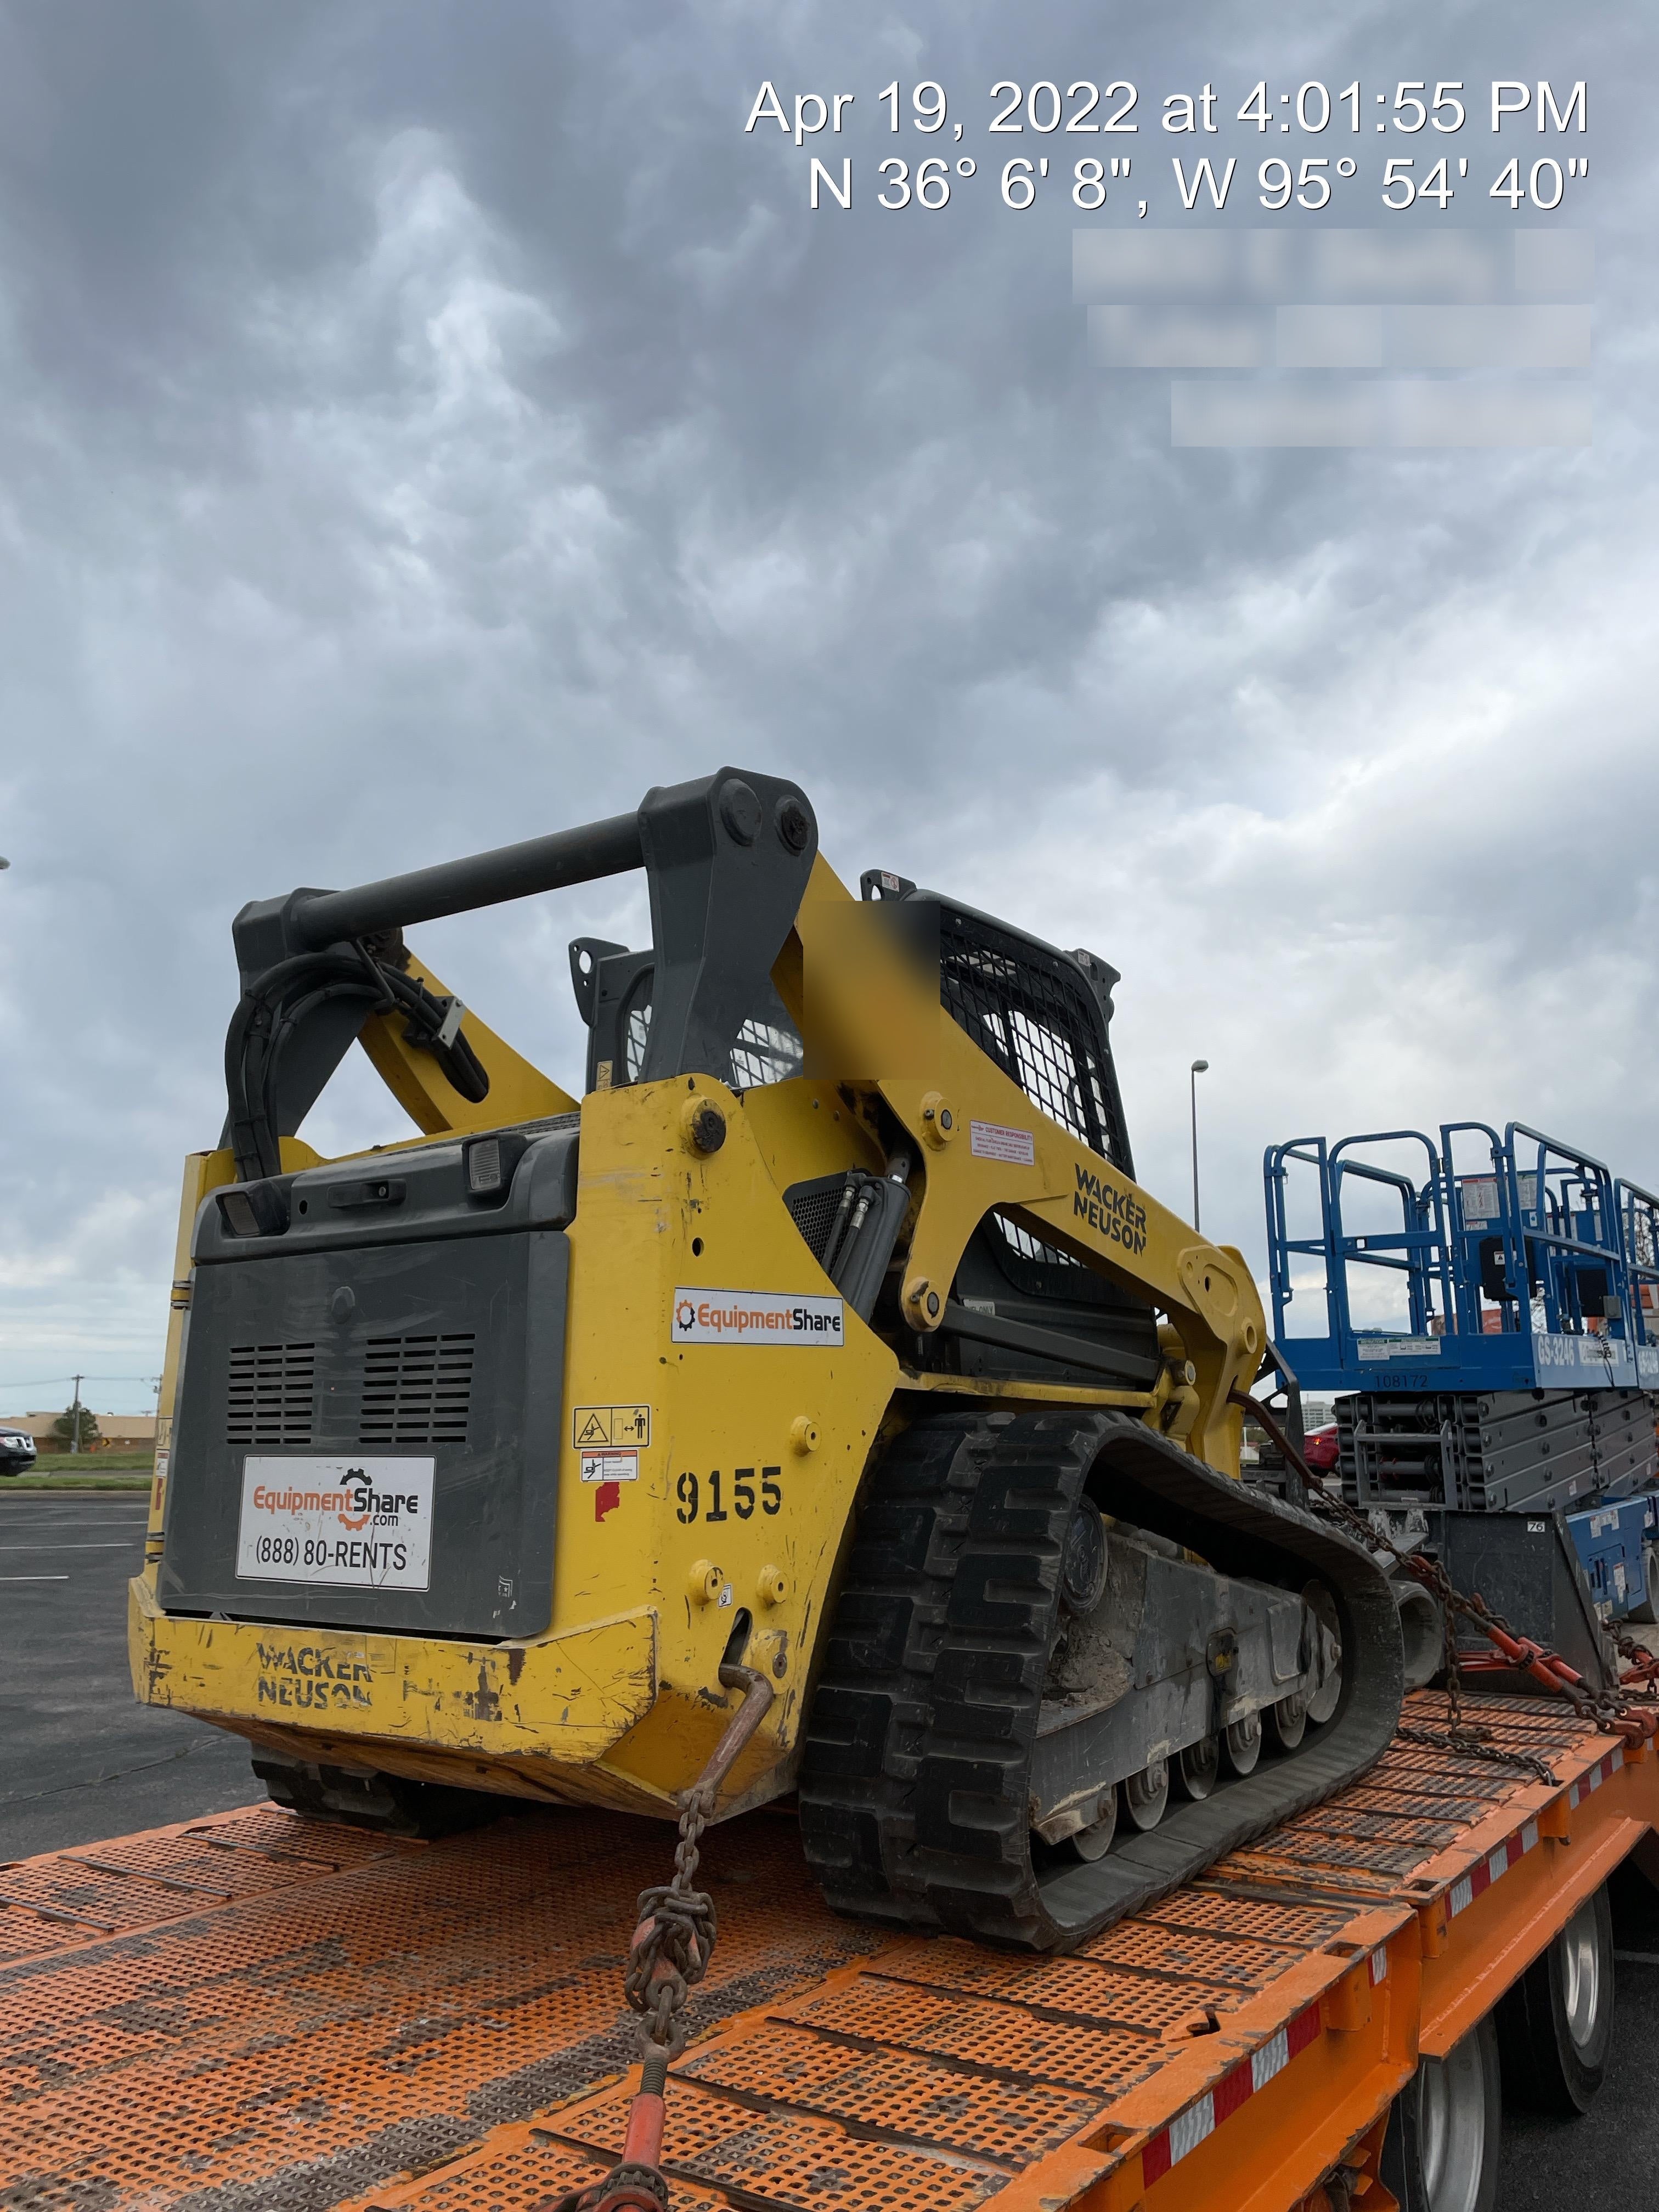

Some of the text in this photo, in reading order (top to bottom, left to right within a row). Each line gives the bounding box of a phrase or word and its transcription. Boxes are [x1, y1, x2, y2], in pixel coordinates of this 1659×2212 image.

[985, 1126, 1005, 1136] CUSTOMER
[1006, 1131, 1032, 1142] RESPONSIBILITY
[1075, 1163, 1147, 1234] WACKER
[1074, 1191, 1147, 1257] NEUSON
[697, 1304, 840, 1333] EquipmentShare
[1538, 1335, 1575, 1367] GS-3246
[1375, 1374, 1429, 1388] 108172
[253, 1486, 418, 1515] EquipmentShare
[676, 1466, 781, 1524] 9155
[370, 1515, 399, 1527] .com
[1528, 1522, 1543, 1531] 76
[256, 1535, 407, 1571] (888) 80-RENTS
[256, 1642, 373, 1683] WACKER
